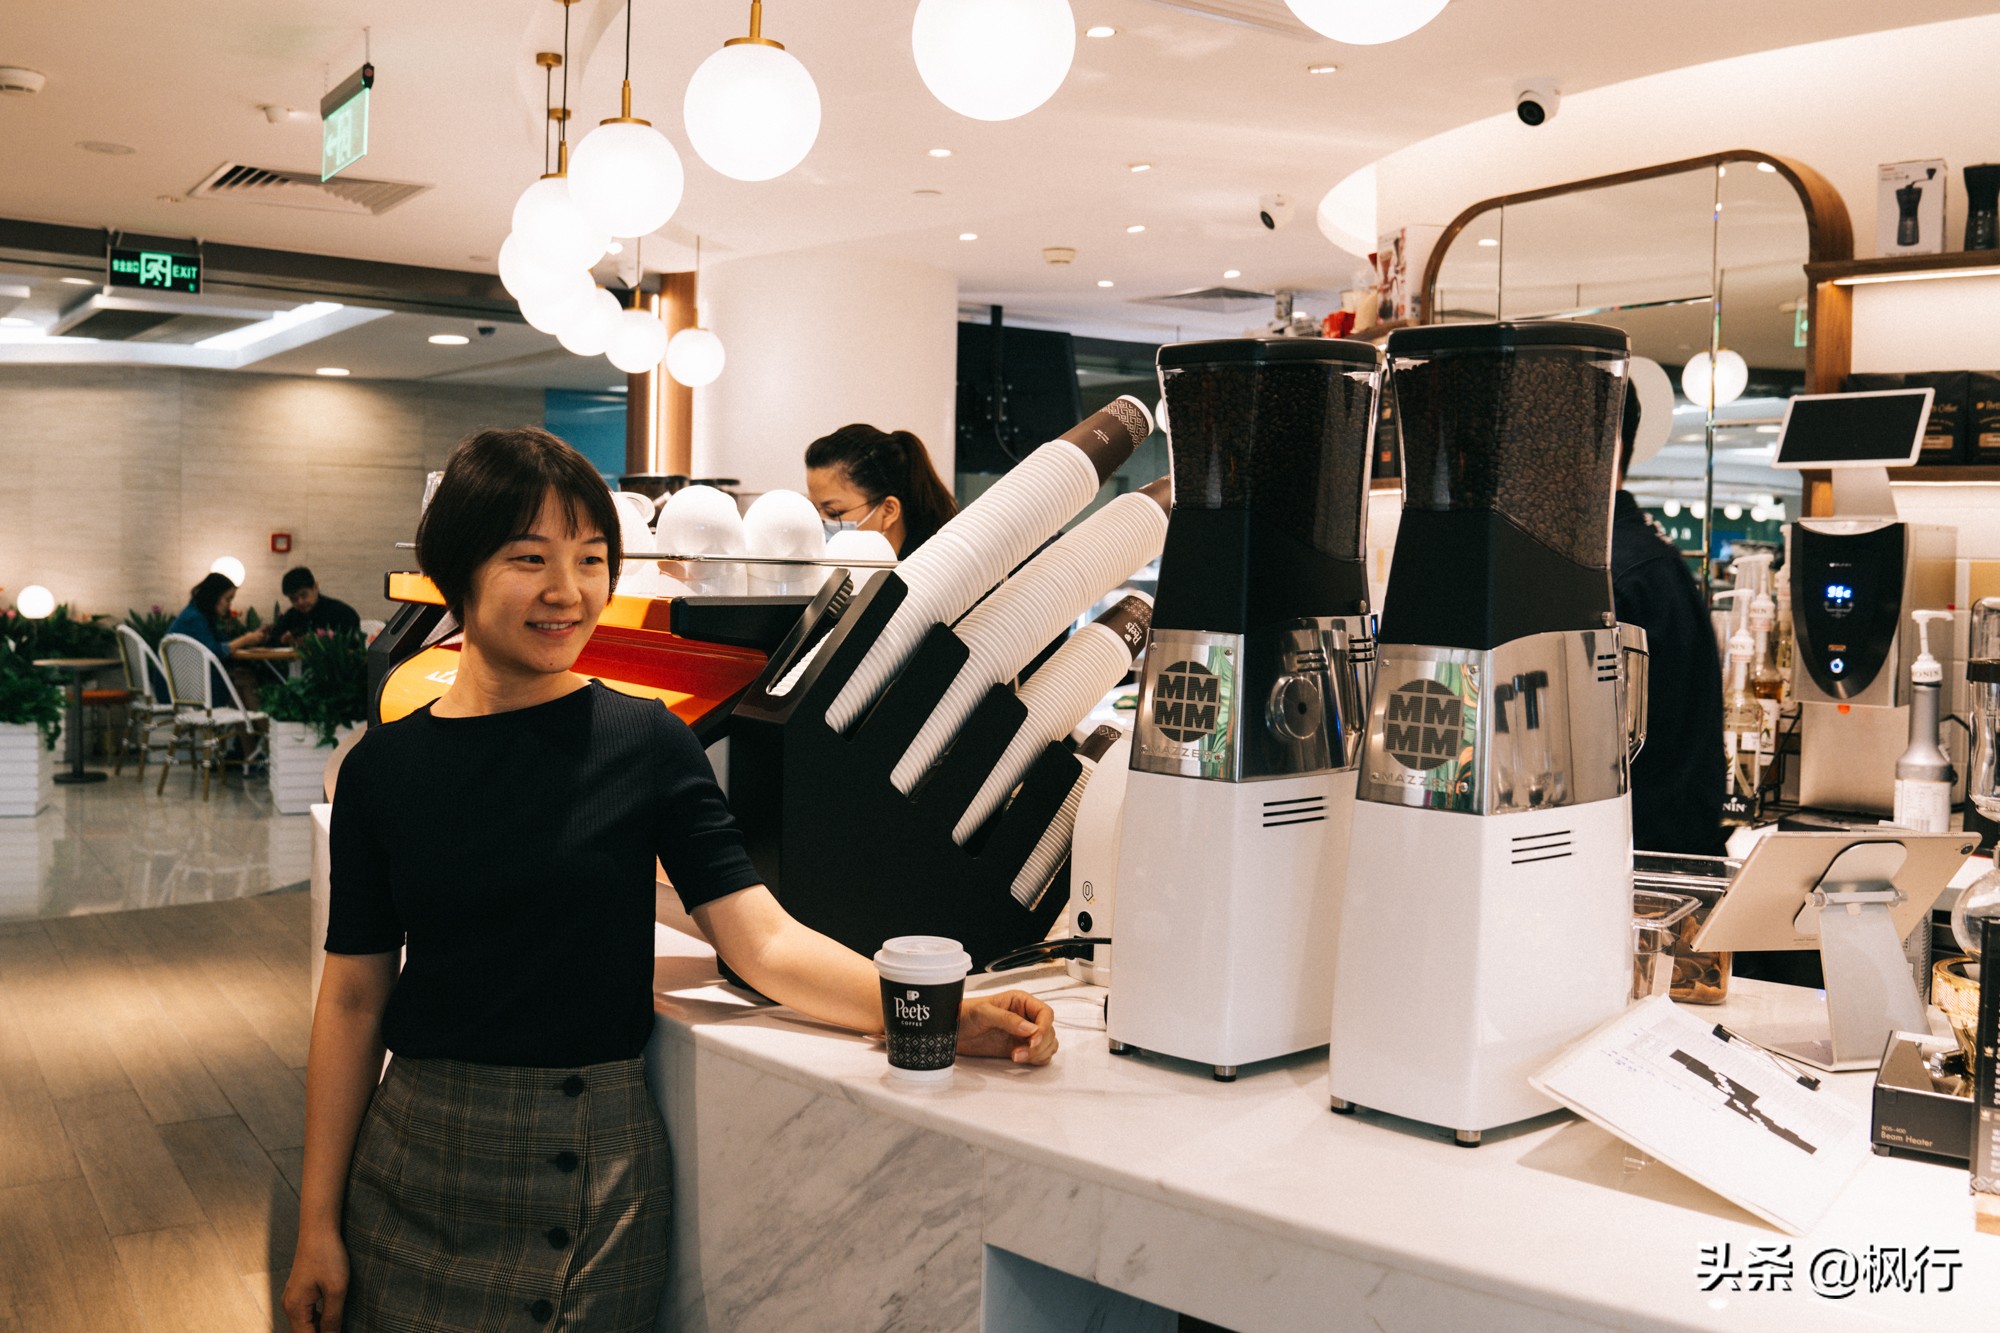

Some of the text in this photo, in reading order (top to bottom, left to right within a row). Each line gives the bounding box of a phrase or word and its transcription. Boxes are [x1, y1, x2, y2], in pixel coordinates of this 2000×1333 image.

[172, 264, 198, 279] EXIT
[893, 996, 930, 1021] Peet's
[1881, 1131, 1933, 1147] Beam Heater
